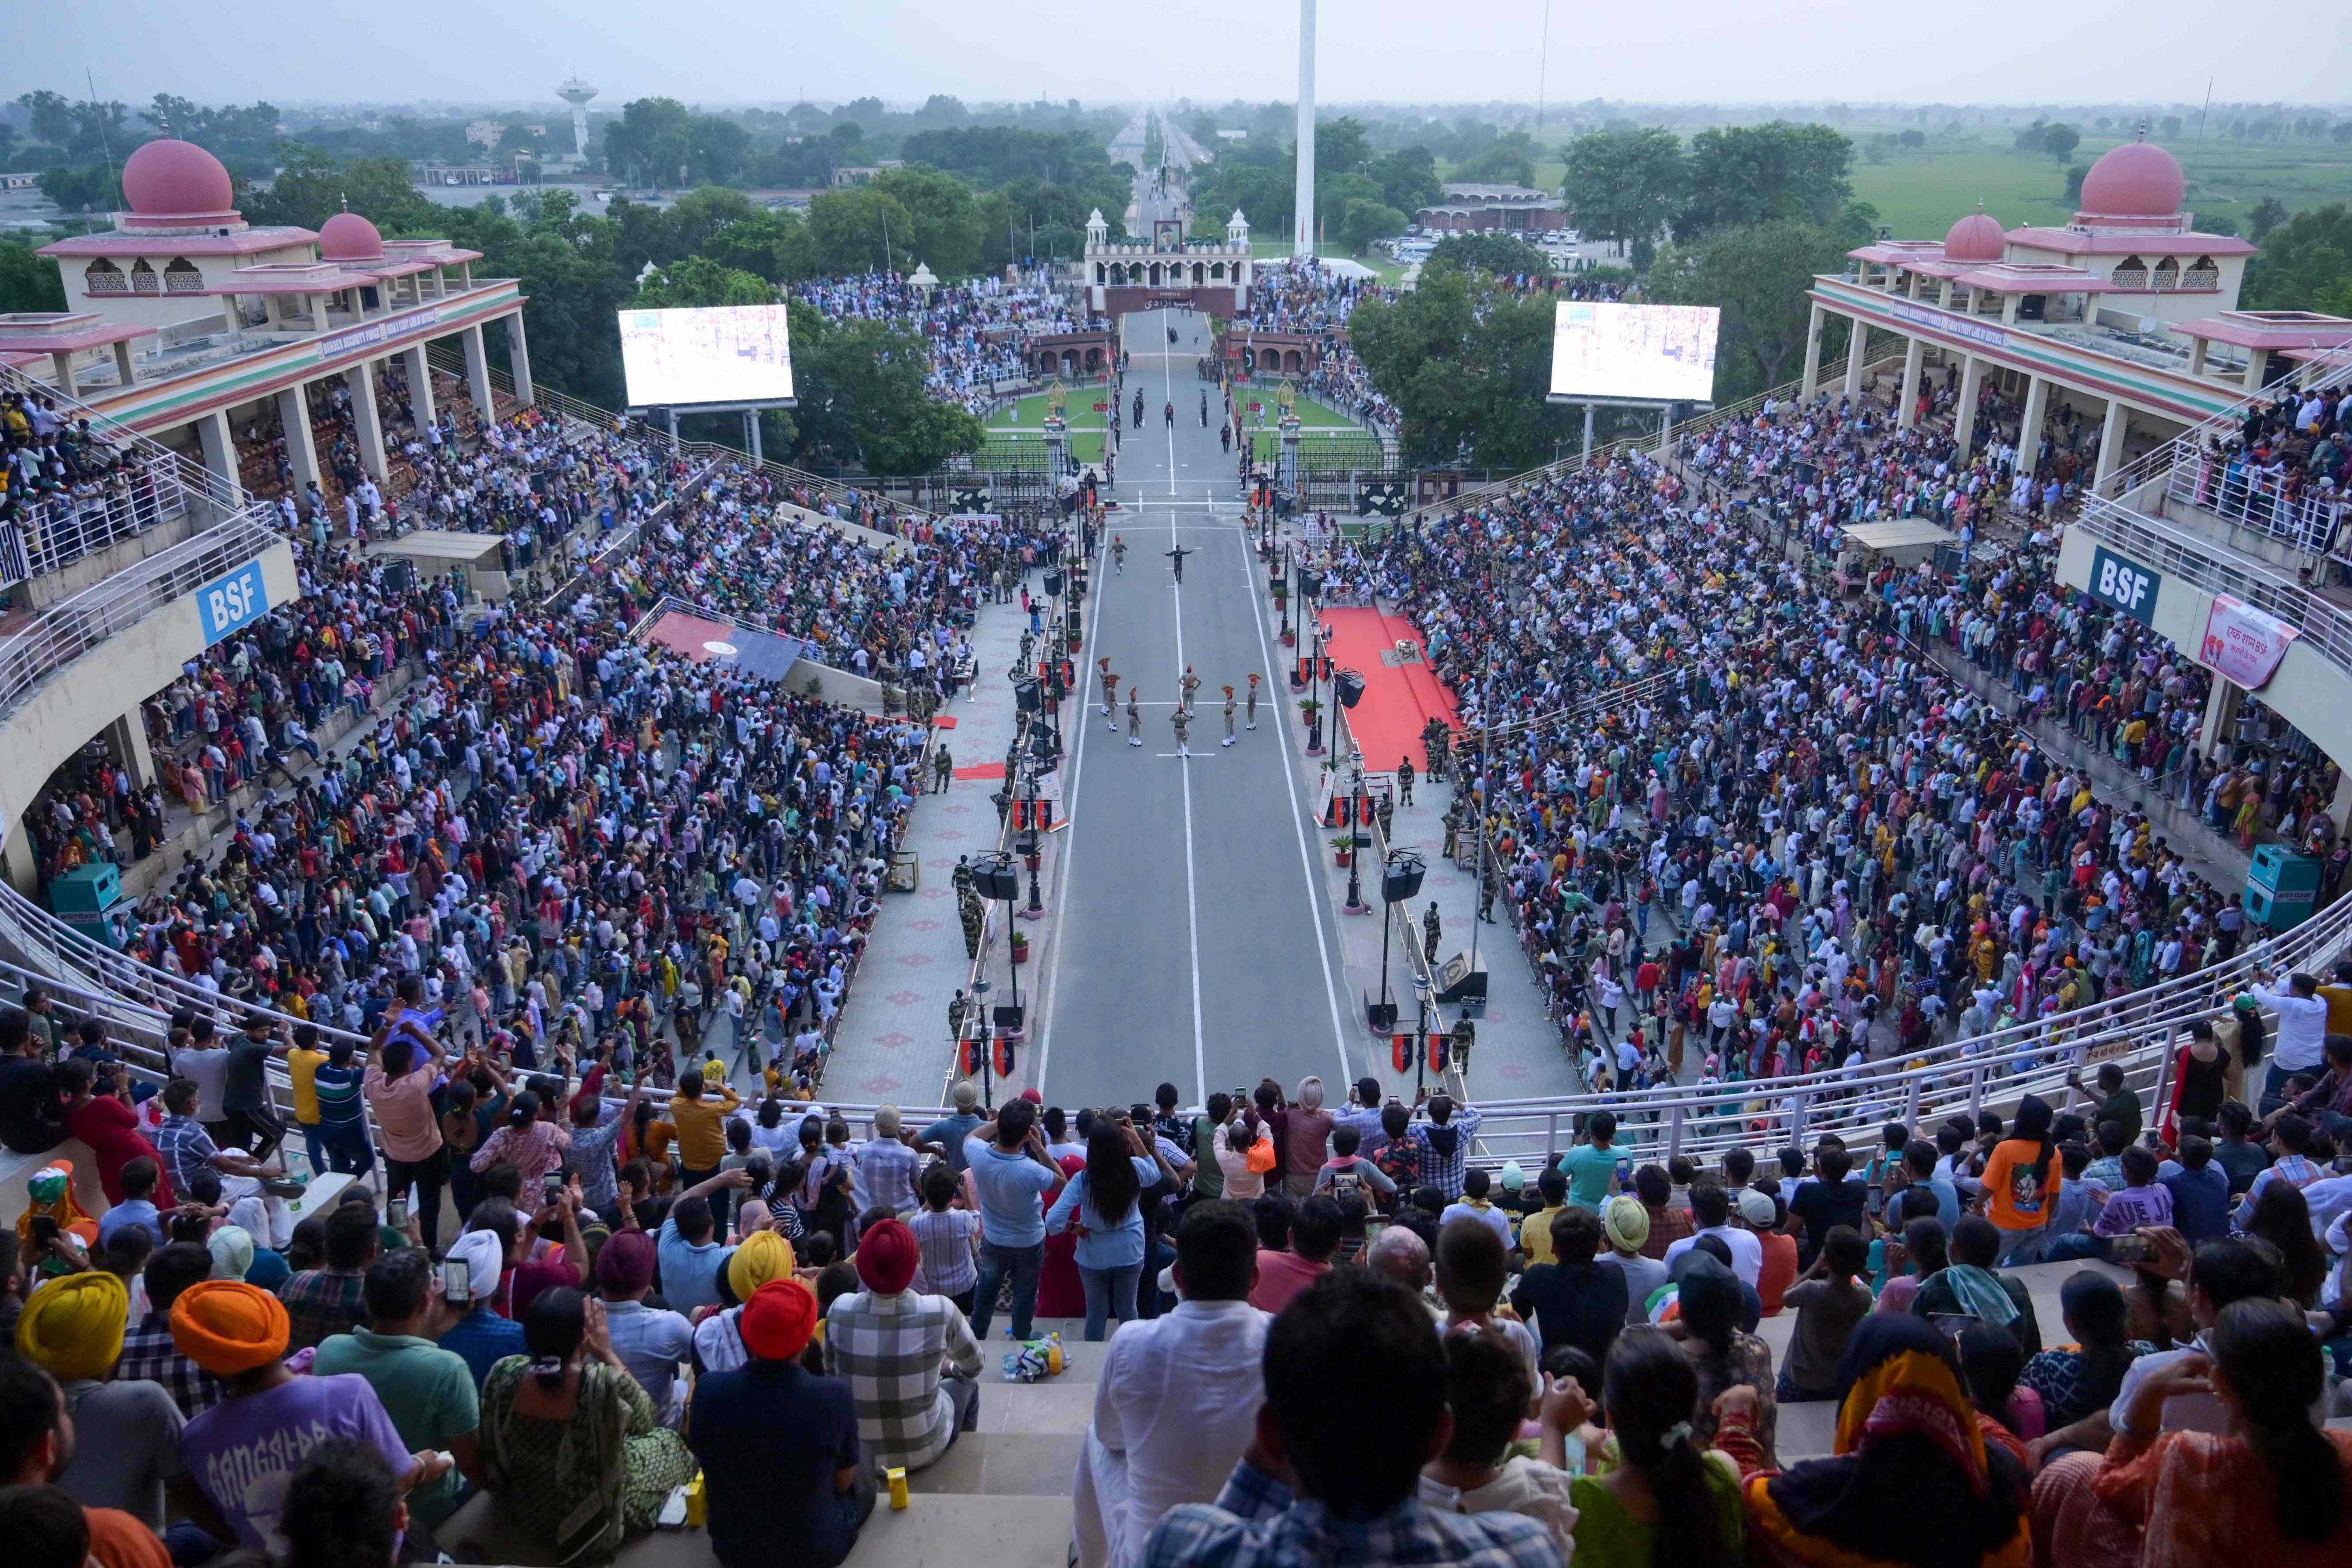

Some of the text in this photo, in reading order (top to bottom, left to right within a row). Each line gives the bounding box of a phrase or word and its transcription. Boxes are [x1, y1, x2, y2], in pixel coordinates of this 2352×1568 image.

[1893, 303, 1942, 327] BORDER SECURITY FORCE
[323, 327, 380, 354] BORDER SECURITY FORCE
[2099, 558, 2149, 610] BSF
[208, 573, 254, 632] BSF
[2227, 626, 2241, 640] एक
[2242, 633, 2256, 650] शाम
[2256, 640, 2268, 656] BSF
